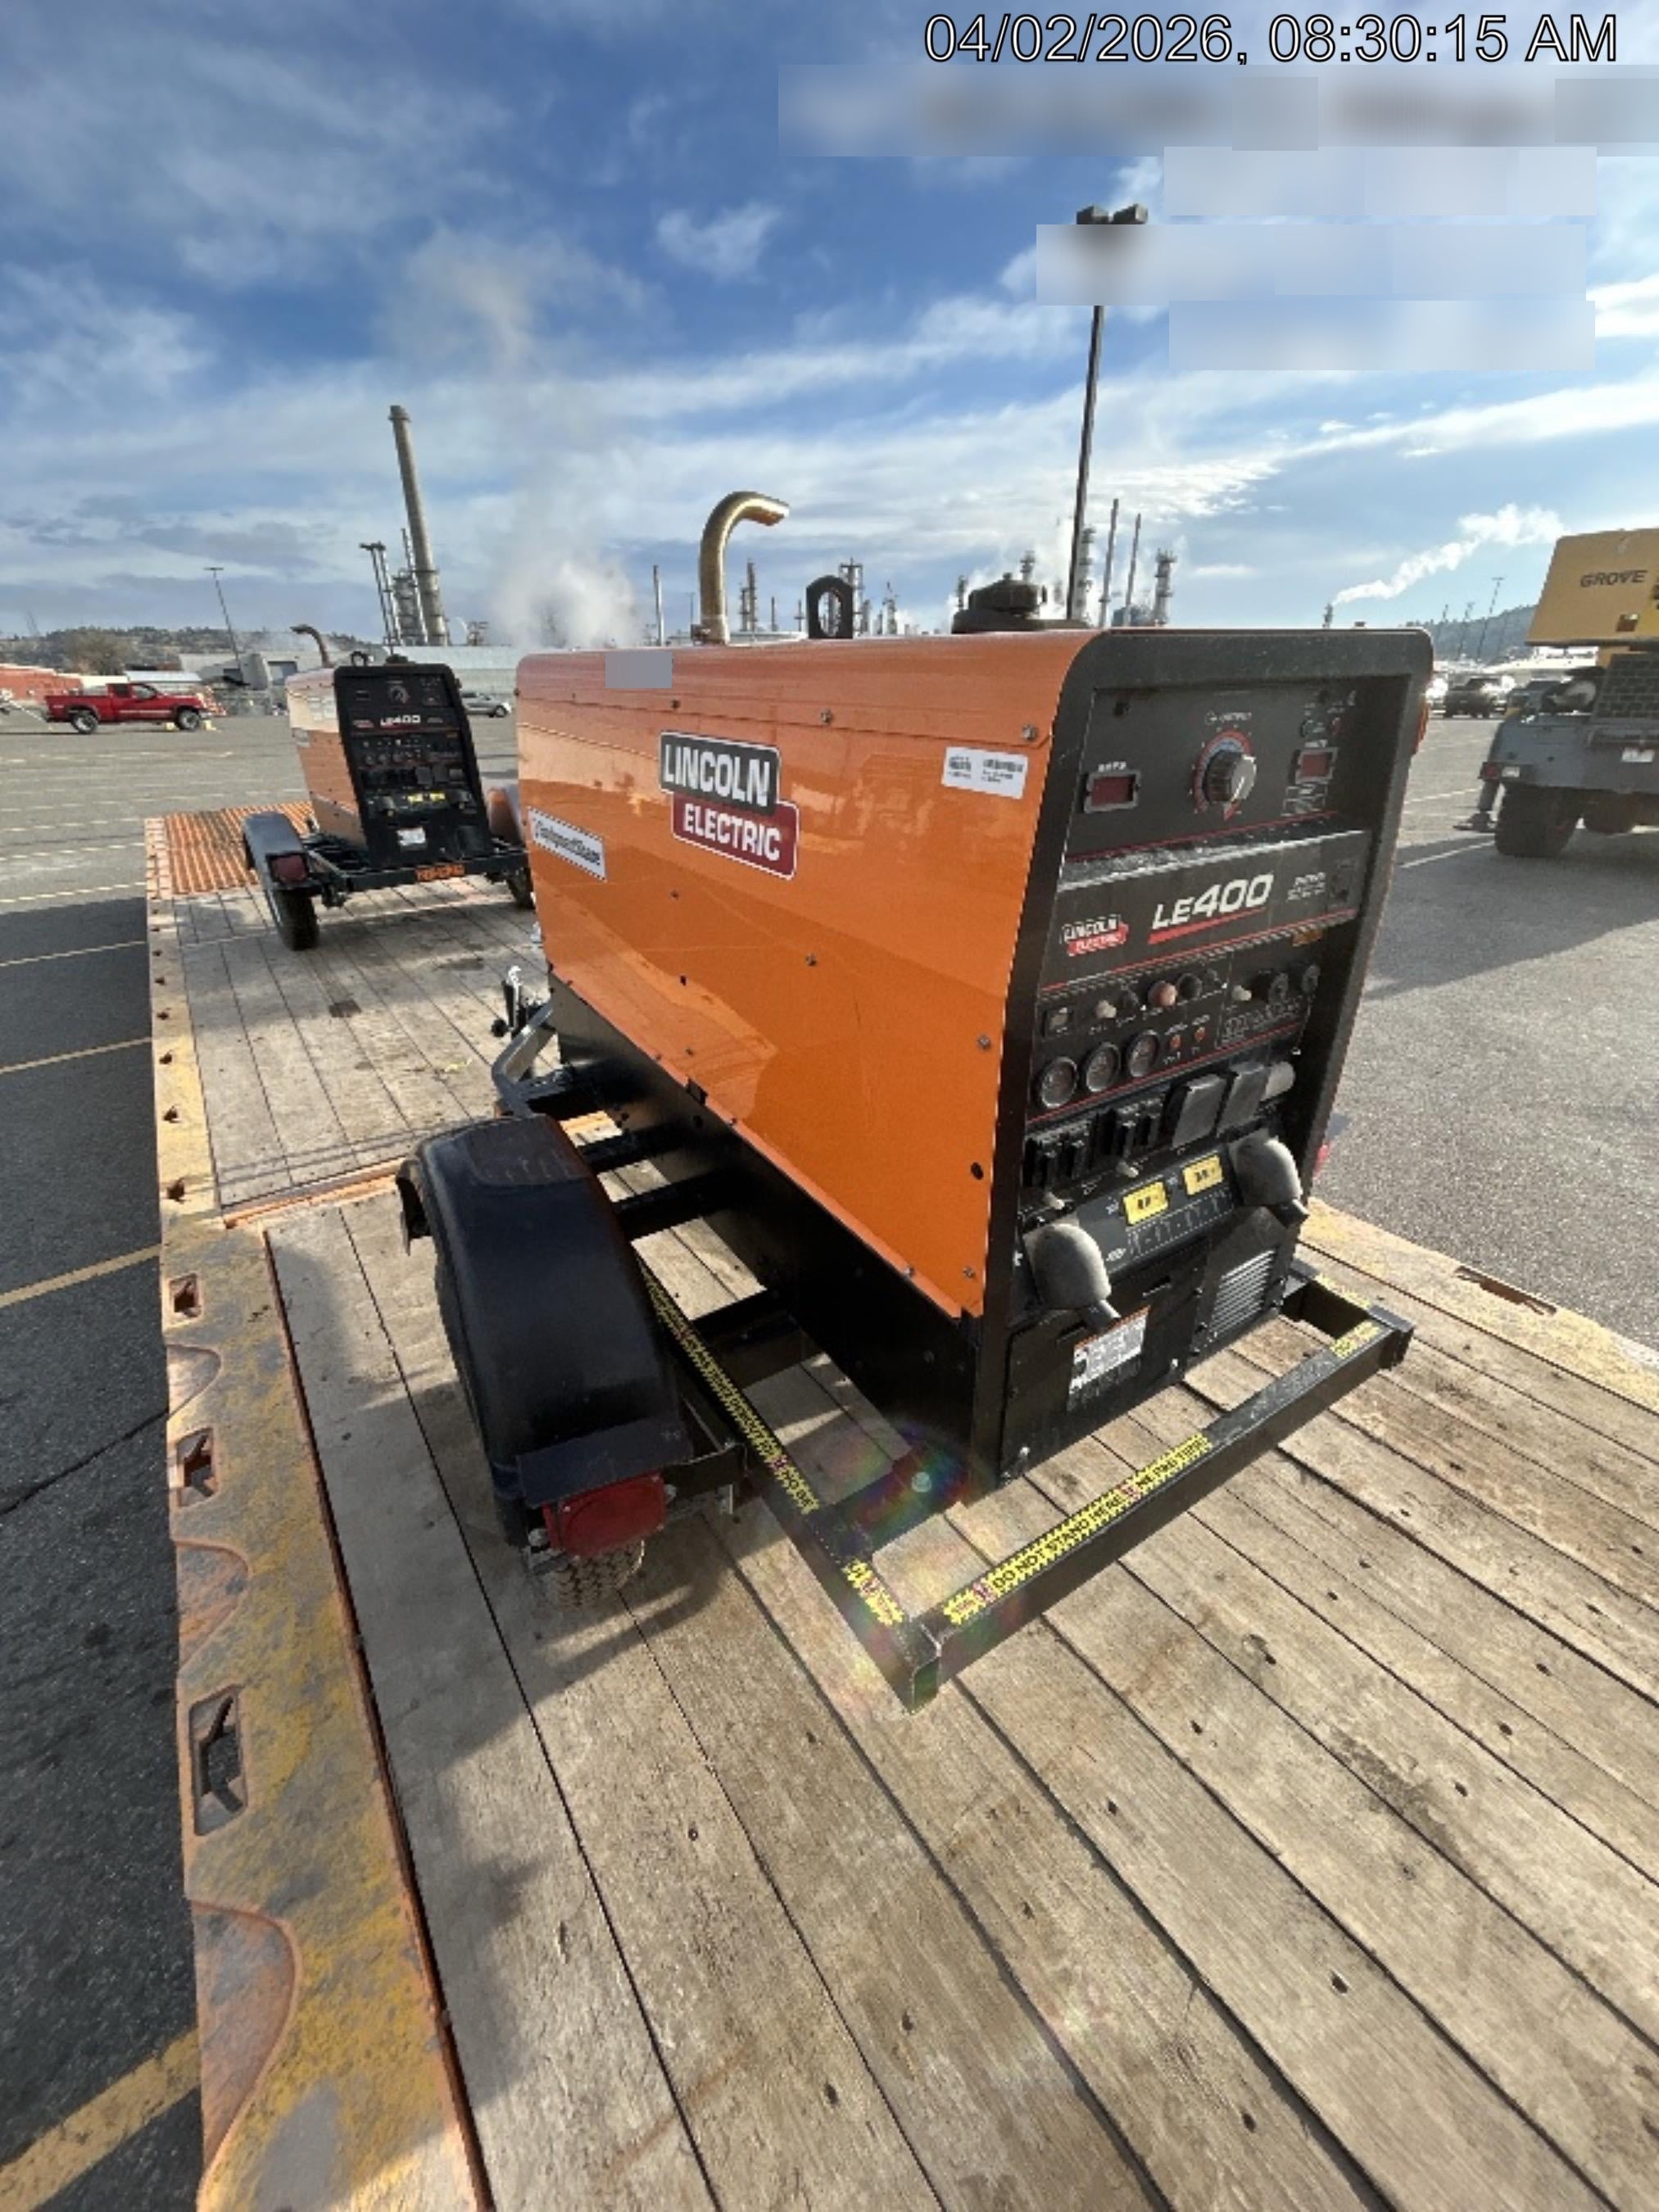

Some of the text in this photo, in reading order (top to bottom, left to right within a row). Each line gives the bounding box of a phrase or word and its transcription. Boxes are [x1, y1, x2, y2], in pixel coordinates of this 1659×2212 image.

[1580, 569, 1648, 588] GROVE
[664, 744, 771, 808] LINCOLN
[683, 803, 781, 861] ELECTRIC
[1152, 873, 1273, 930] LE400
[993, 1569, 1016, 1589] DO
[1015, 1548, 1045, 1574] NOT
